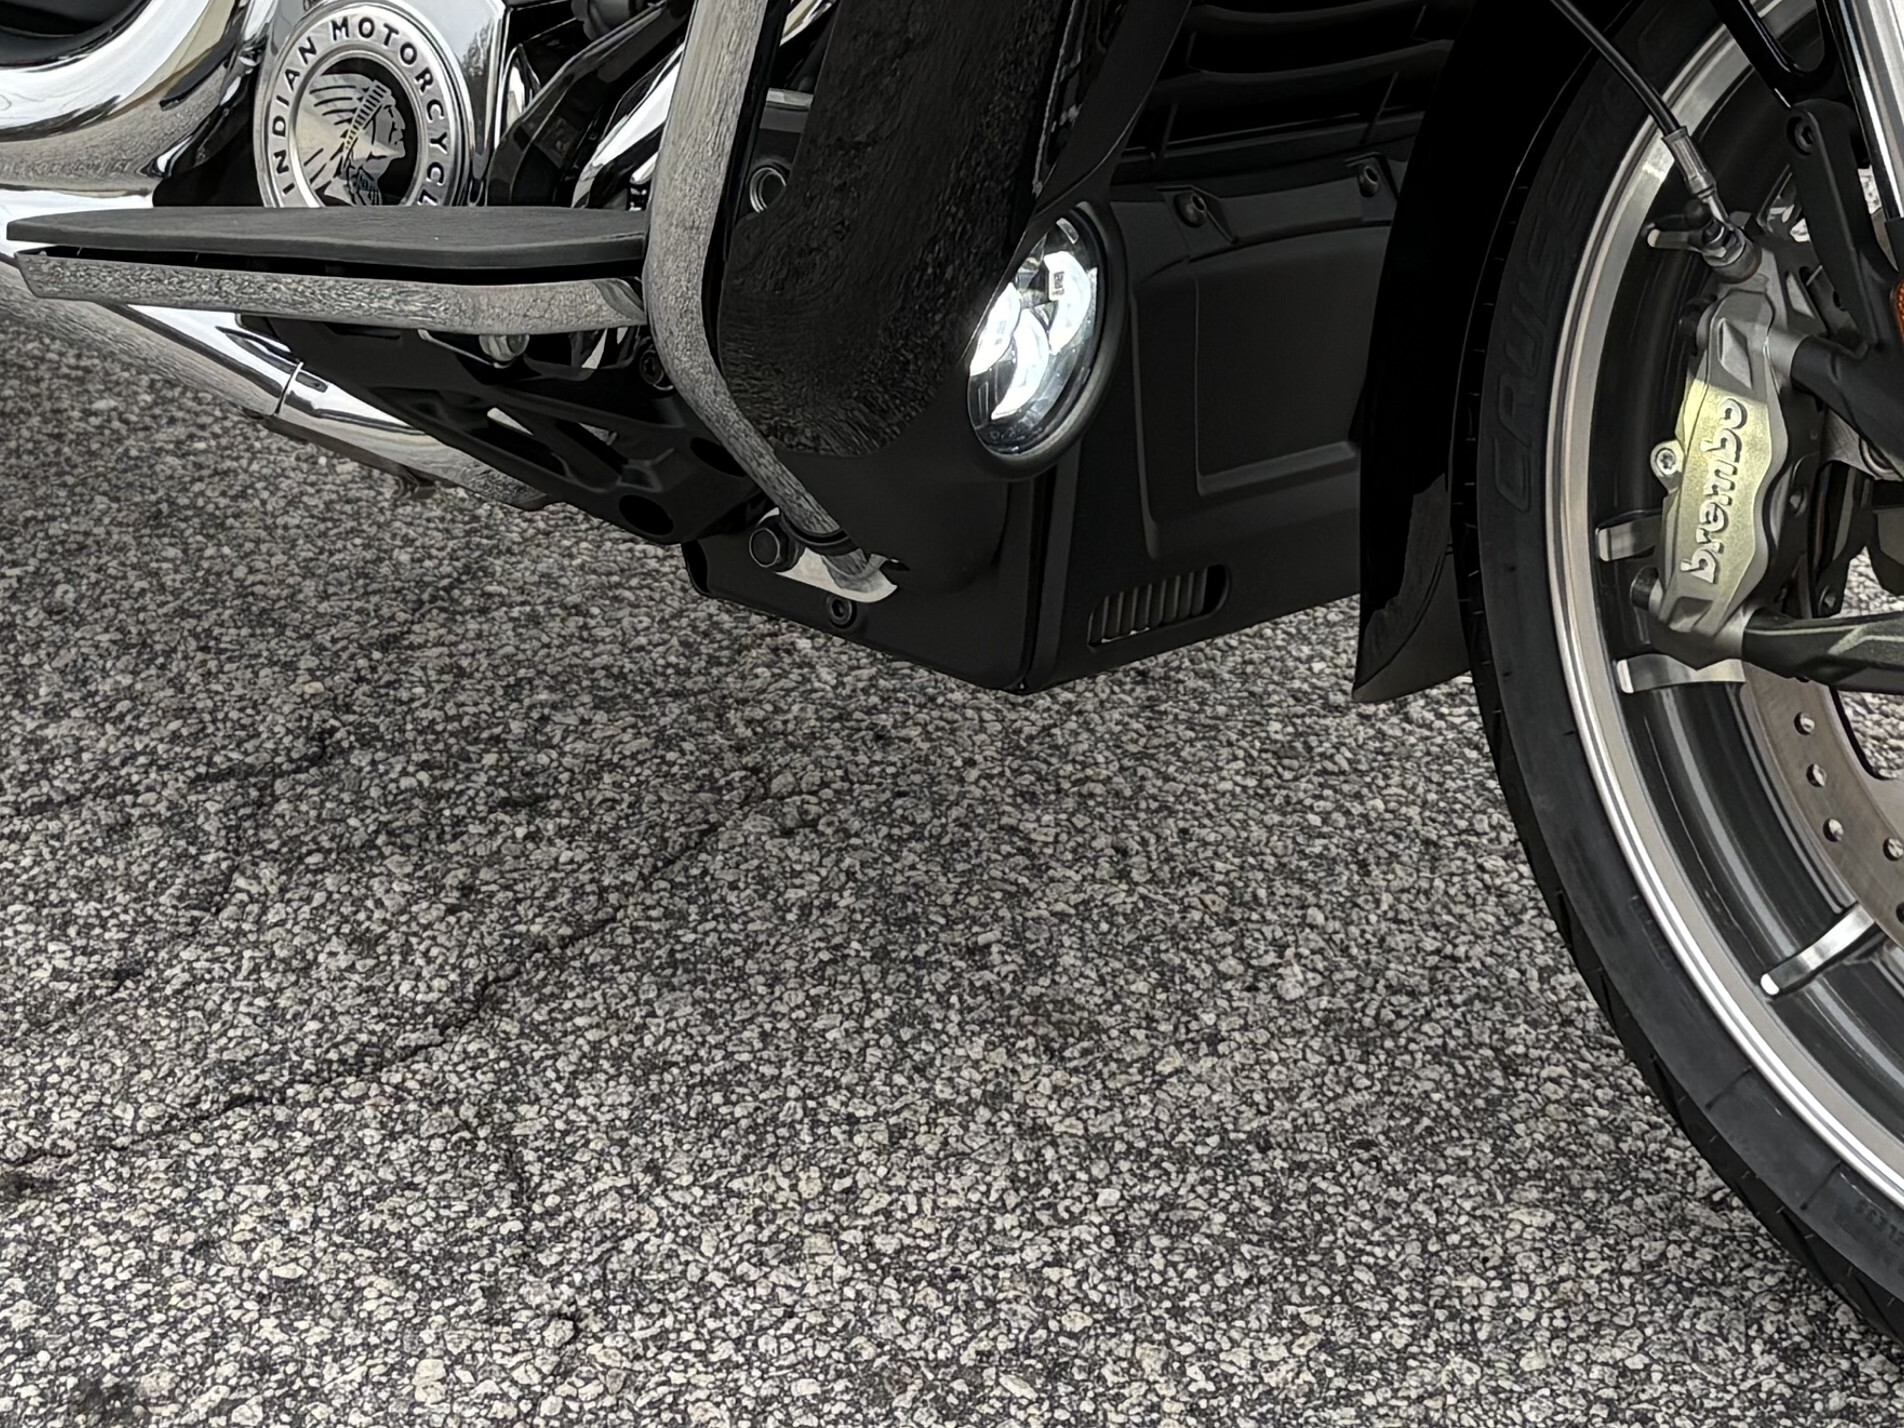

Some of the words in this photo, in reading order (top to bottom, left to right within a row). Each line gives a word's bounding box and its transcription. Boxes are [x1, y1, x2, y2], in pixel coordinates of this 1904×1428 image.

[272, 36, 319, 196] INDIAN
[330, 17, 449, 207] MOTORCYCL
[1679, 397, 1749, 585] brembo
